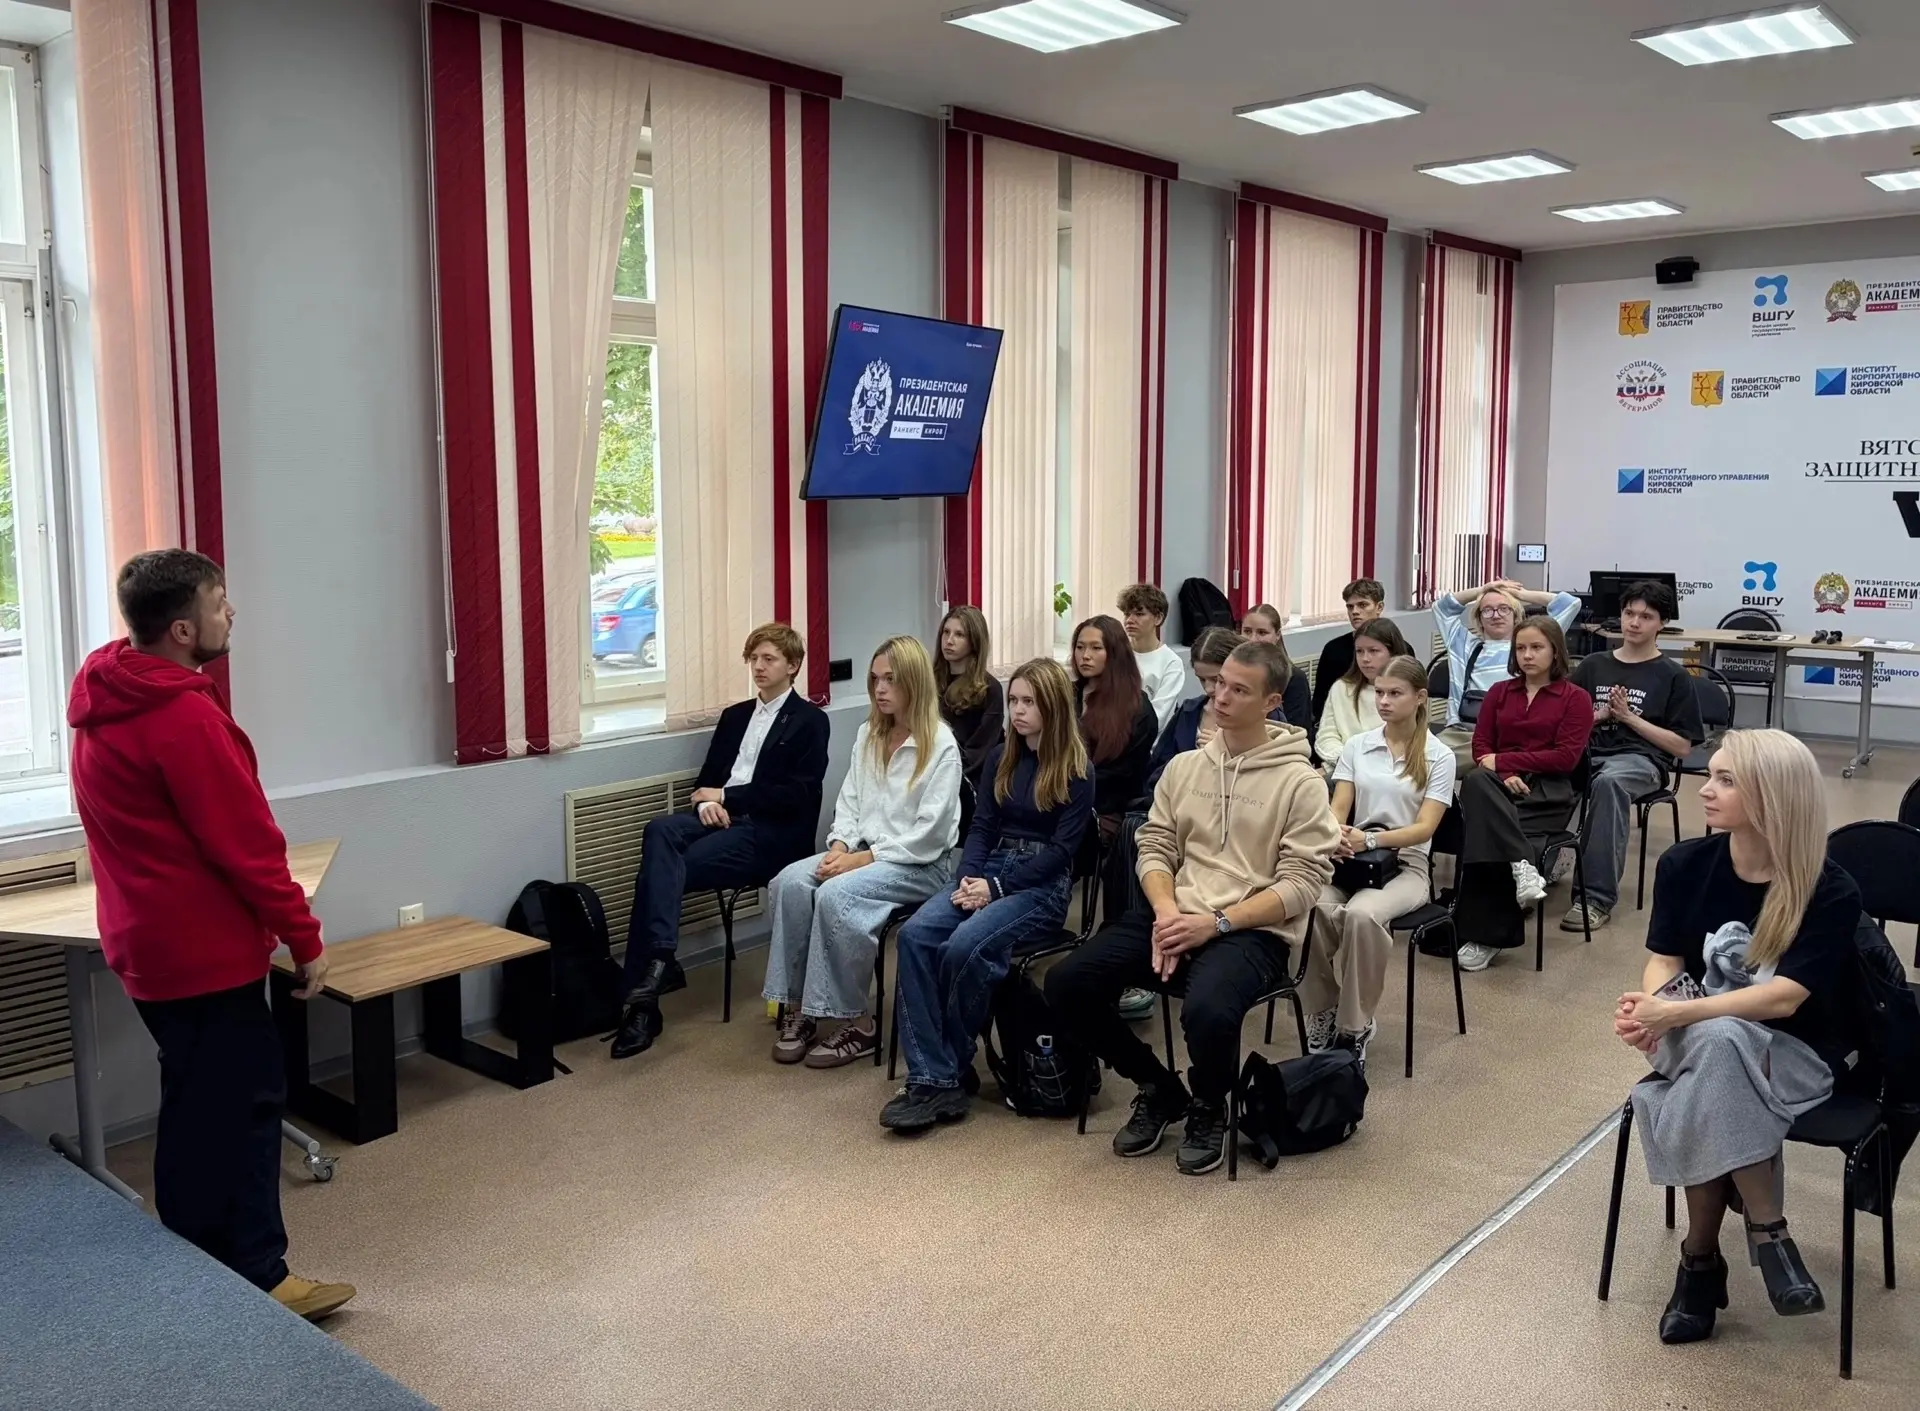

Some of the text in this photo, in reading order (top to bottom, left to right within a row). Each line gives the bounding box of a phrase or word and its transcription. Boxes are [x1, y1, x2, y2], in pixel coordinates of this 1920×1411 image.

[1657, 302, 1723, 313] ПРАВИТЕЛЬСТВО
[1656, 311, 1704, 320] КИРОВСКОЙ
[1752, 310, 1795, 322] ВШГУ
[1656, 319, 1693, 328] ОБЛАСТИ
[1616, 360, 1667, 380] АССОЦИАЦИЯ
[1851, 365, 1897, 374] ИНСТИТУТ
[899, 377, 968, 393] ПРЕЗИДЕНТСКАЯ
[1731, 375, 1801, 385] ПРАВИТЕЛЬСТВО
[1850, 379, 1903, 388] КИРОВСКОЙ
[1623, 384, 1659, 396] СВО
[1731, 383, 1781, 392] КИРОВСКОЙ
[1731, 391, 1769, 399] ОБЛАСТИ
[894, 393, 965, 419] АКАДЕМИЯ
[1619, 397, 1663, 412] ВЕТЕРАНОВ
[894, 426, 920, 434] РАНХИГС
[1805, 462, 1920, 479] ЗАЩИТН
[1647, 480, 1693, 488] КИРОВСКОЙ
[1675, 581, 1713, 589] ТЕЛЬСТВО
[1854, 587, 1920, 599] АКАДЕМИ
[1741, 595, 1784, 606] ВШГУ
[1722, 656, 1774, 667] ПРАВИТЕЛЬС
[1839, 667, 1919, 677] КОРПАТИВНОГО
[1839, 673, 1891, 682] КИРОКОЙ
[1838, 680, 1879, 688] ОБЛАИ
